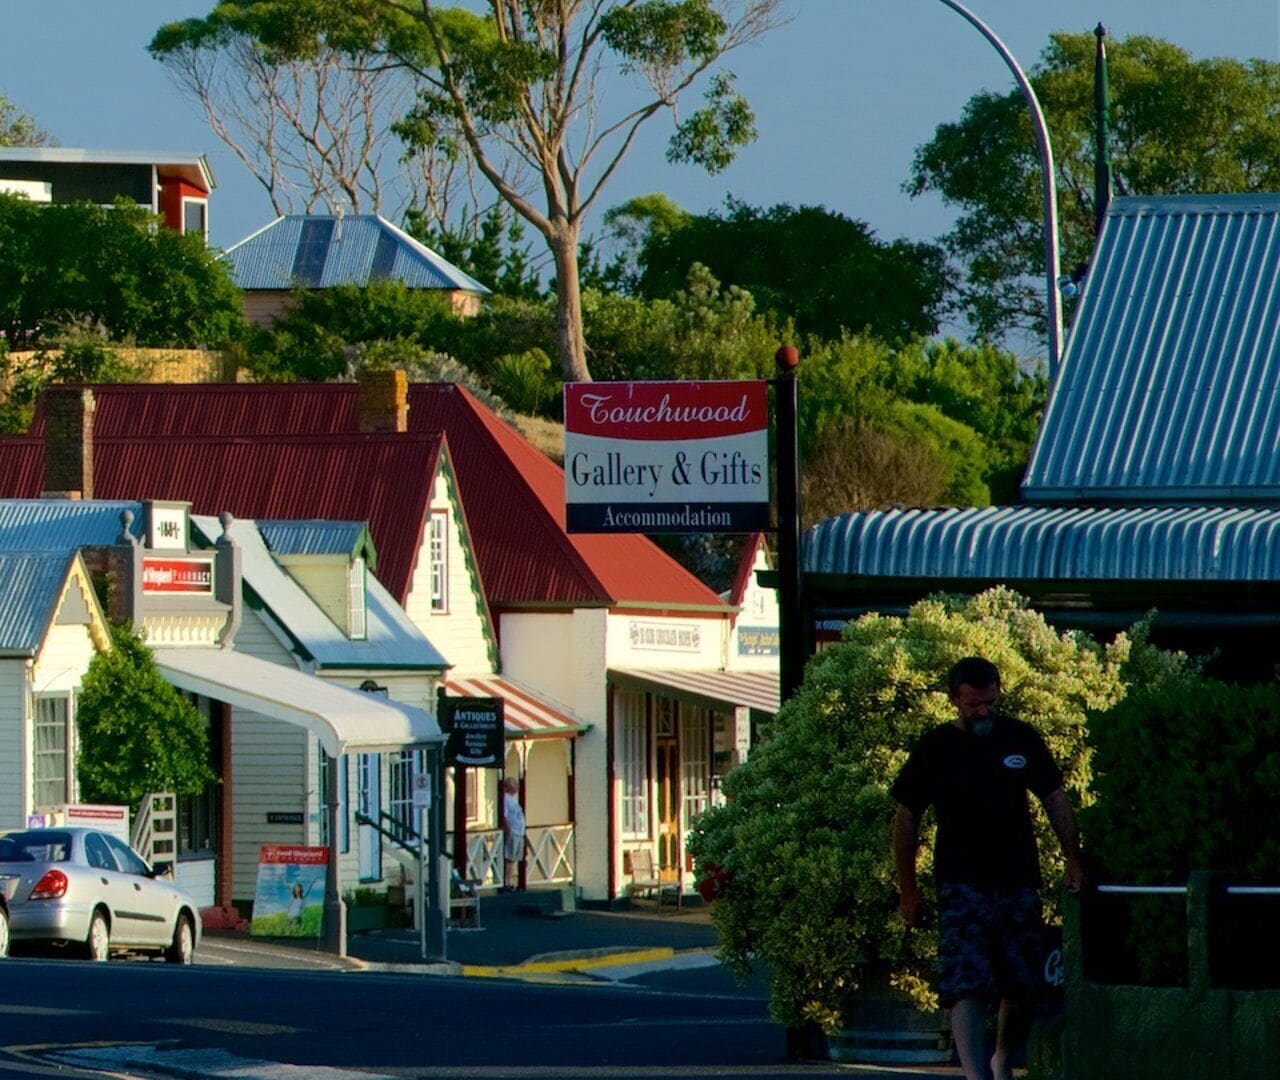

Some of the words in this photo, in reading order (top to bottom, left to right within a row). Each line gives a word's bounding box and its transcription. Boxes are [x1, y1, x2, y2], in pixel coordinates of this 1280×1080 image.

[580, 393, 751, 425] Touchwood
[571, 451, 664, 497] Gallery
[671, 451, 692, 486] &
[700, 450, 762, 486] Gifts
[602, 504, 732, 527] Accommodation
[173, 568, 211, 583] PHARMACY
[454, 709, 496, 722] ANTIQUES
